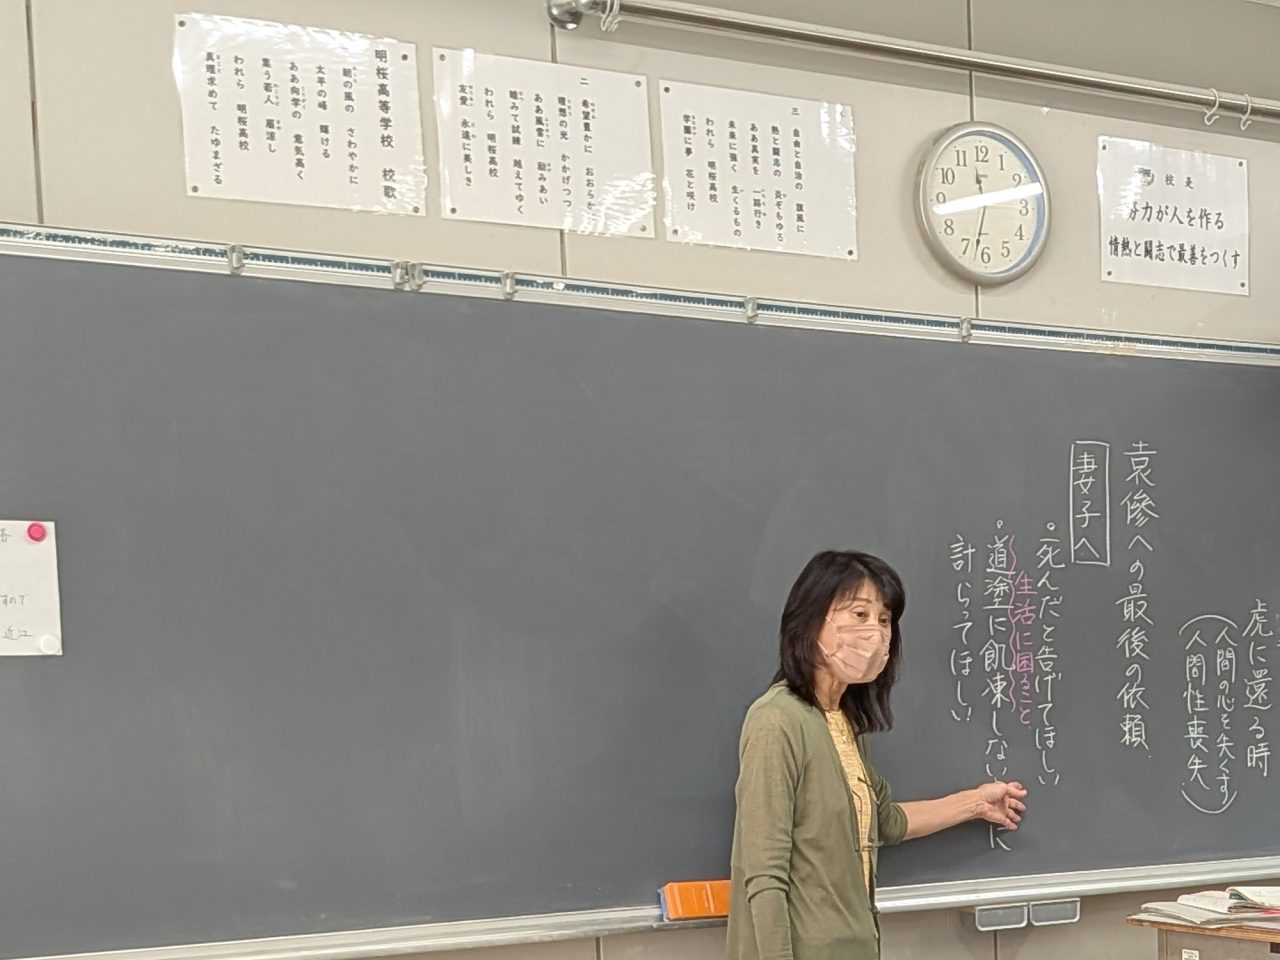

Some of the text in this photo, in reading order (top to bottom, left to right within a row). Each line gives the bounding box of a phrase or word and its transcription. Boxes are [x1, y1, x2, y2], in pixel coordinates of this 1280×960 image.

[233, 54, 250, 152] われら 明桜高校
[580, 77, 590, 86] 二
[205, 51, 223, 185] 真理求めて たゆまざる
[289, 62, 305, 181] ああ向学の 意気高く
[375, 49, 397, 200] 明桜高等学校 校歌
[484, 87, 499, 178] われら 明桜高校
[791, 107, 800, 116] 三
[346, 127, 359, 185] さわやかに
[561, 153, 572, 207] かかげつつ
[705, 117, 719, 203] われら 明桜高校
[940, 167, 955, 185] 10
[955, 149, 968, 167] 11
[975, 145, 989, 163] 12
[998, 154, 1005, 171] 1
[585, 167, 597, 220] おおらか
[1019, 198, 1029, 216] 3
[944, 218, 954, 236] 8
[961, 238, 971, 255] 7
[1001, 241, 1011, 258] 5
[1014, 224, 1024, 241] 4
[1108, 235, 1241, 269] 情熱と闘志で最善をつくす
[981, 247, 991, 264] 6
[1072, 451, 1100, 559] 妻子へ
[950, 534, 976, 722] 計らってほしい
[1013, 570, 1038, 726] 生活に困ること
[1035, 538, 1066, 786] 死んだと告げてほしい
[1242, 598, 1274, 777] 虎に還る時
[1182, 630, 1211, 790] 人間性喪失
